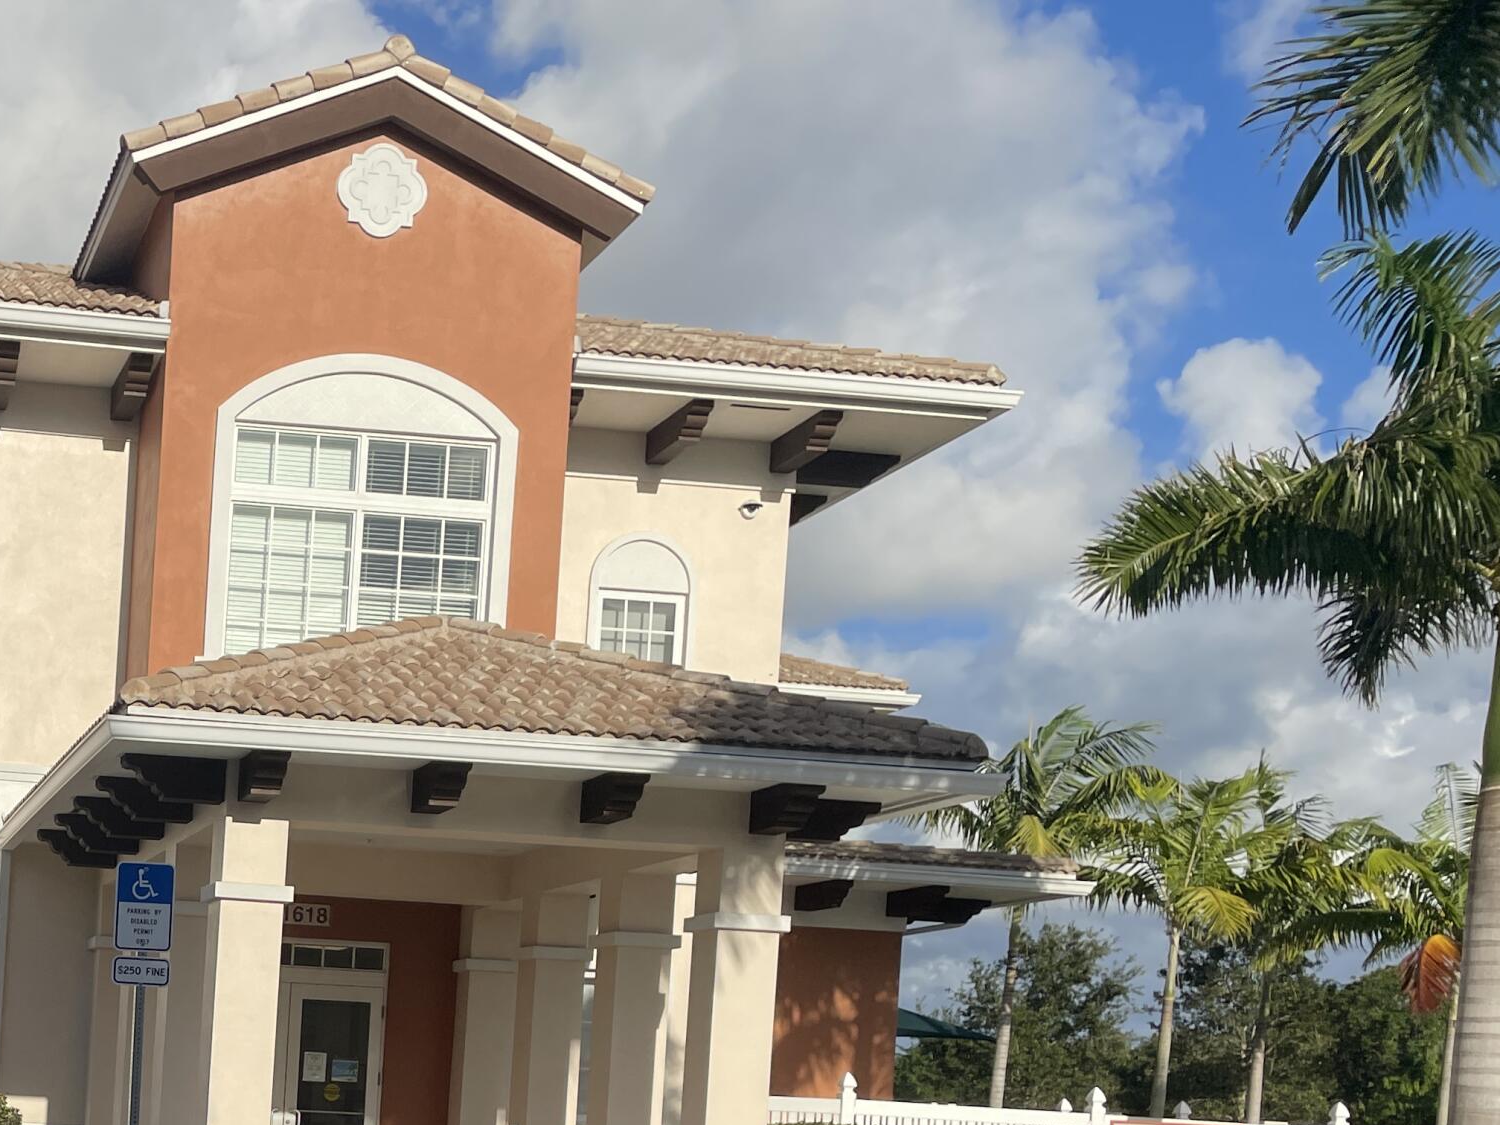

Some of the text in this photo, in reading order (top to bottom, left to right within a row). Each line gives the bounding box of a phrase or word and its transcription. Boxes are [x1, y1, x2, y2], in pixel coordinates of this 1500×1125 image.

[127, 907, 151, 916] PARKING
[130, 917, 158, 926] DISABLED
[117, 965, 165, 977] $250 FINE
